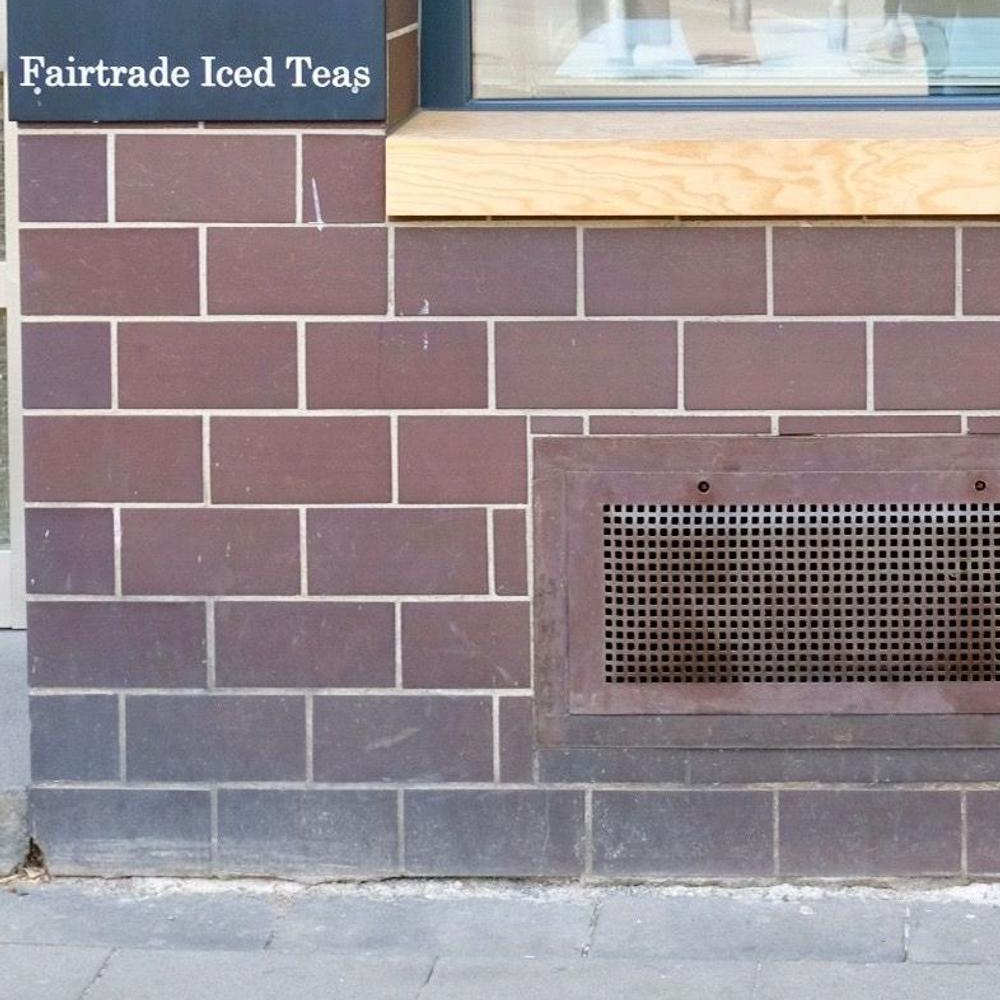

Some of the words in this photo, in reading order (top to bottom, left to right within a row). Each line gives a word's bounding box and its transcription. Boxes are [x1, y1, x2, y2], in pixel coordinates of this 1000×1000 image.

[20, 55, 190, 87] Fairtrade
[201, 55, 275, 87] Iced
[286, 56, 371, 88] Teas
